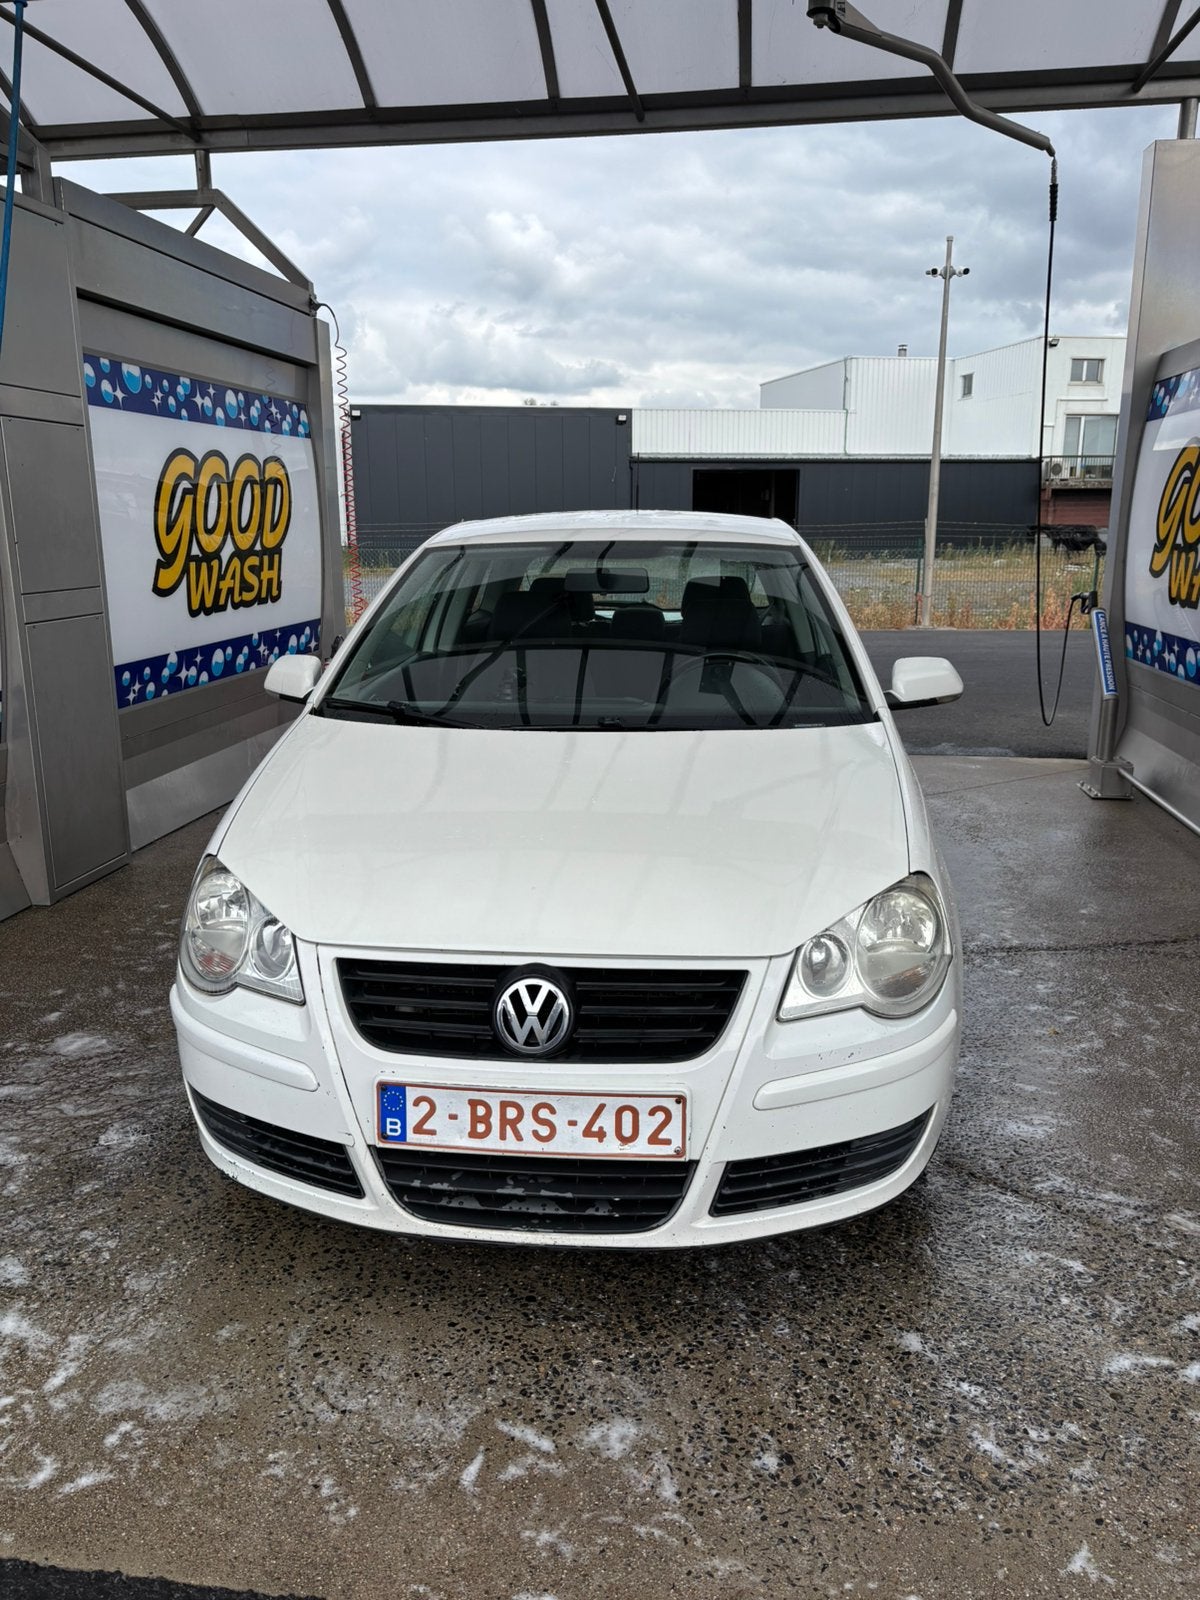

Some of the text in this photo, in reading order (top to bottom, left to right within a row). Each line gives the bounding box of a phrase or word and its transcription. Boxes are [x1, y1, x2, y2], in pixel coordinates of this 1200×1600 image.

[186, 548, 283, 618] WASH
[1098, 613, 1108, 633] LANCE
[1102, 639, 1111, 659] HAUTE
[1104, 660, 1116, 690] PRESSION
[385, 1095, 674, 1147] B 2-BRS-402
